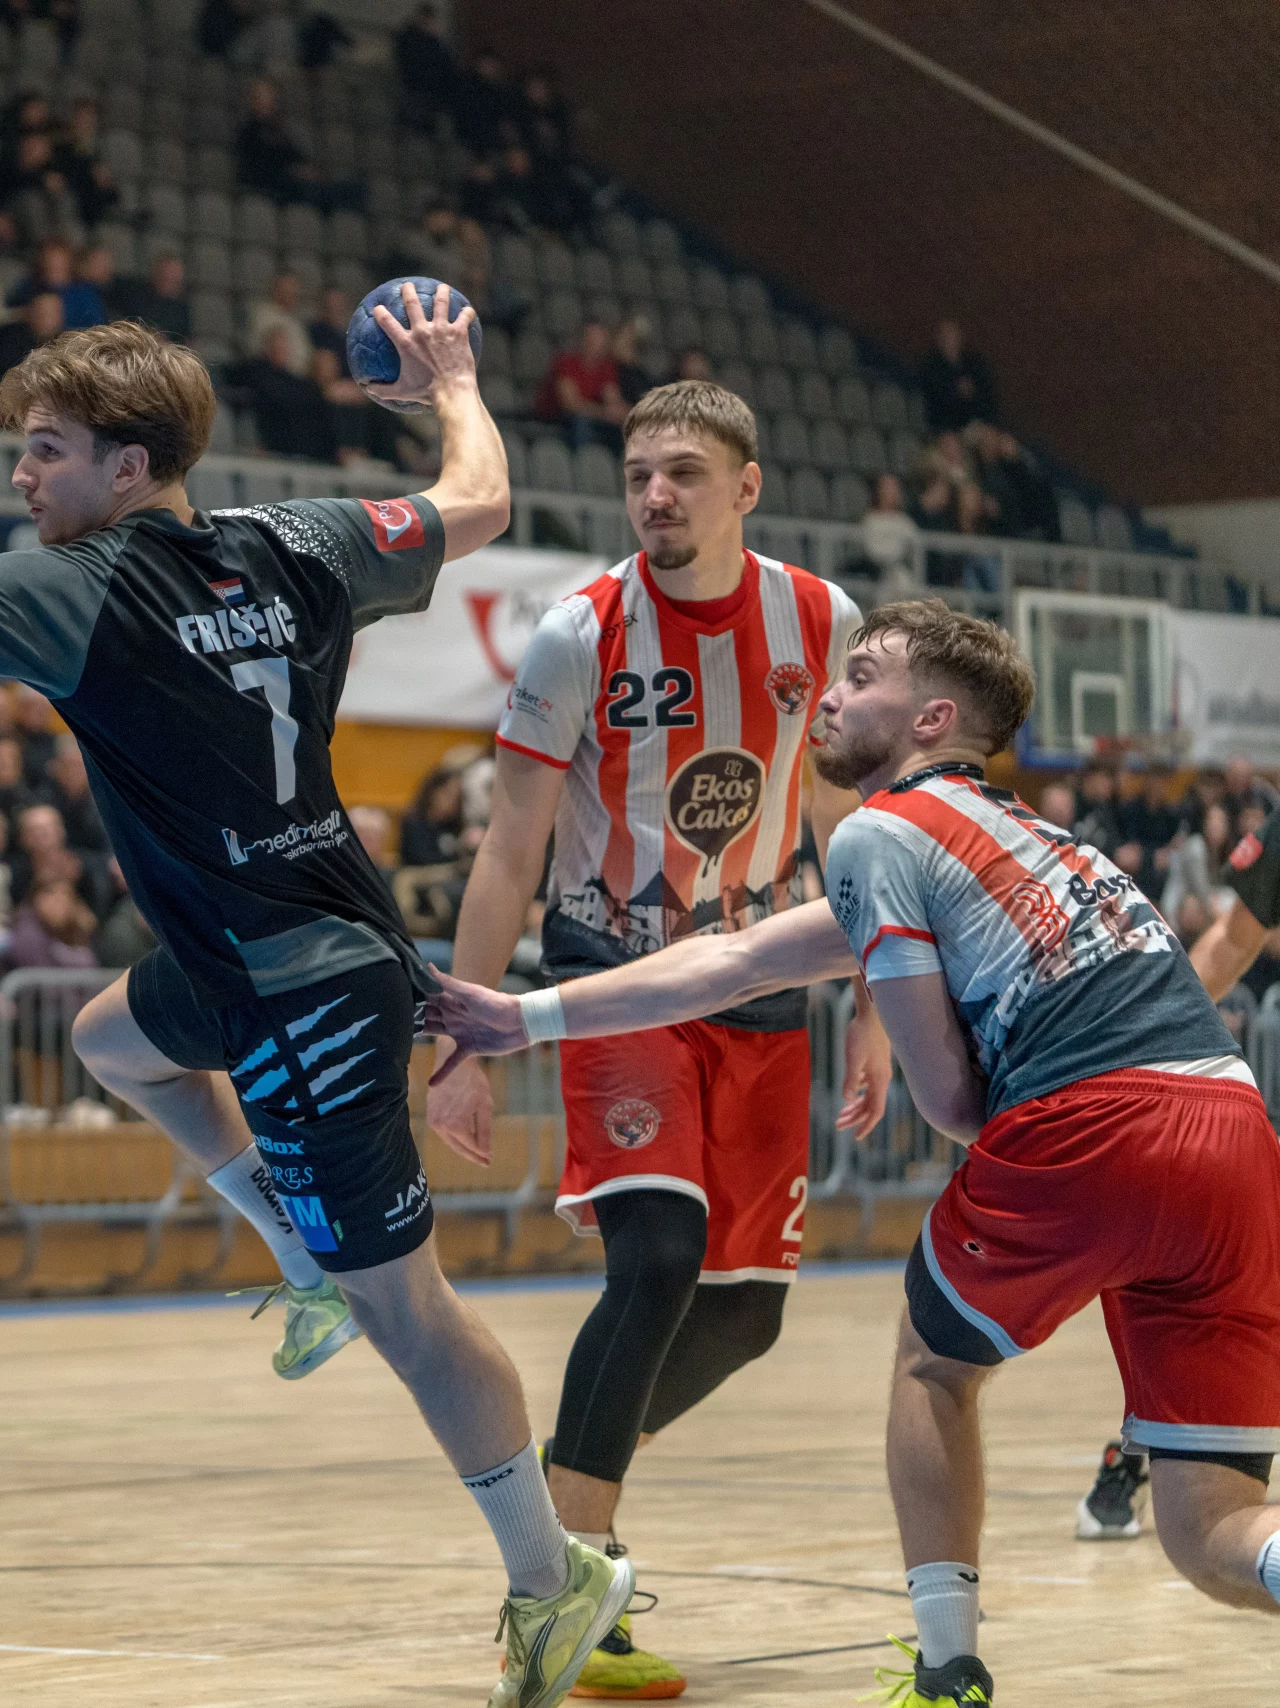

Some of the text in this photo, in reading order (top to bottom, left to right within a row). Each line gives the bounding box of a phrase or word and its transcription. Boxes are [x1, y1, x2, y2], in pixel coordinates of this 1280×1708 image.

[606, 667, 696, 729] 22
[230, 656, 299, 806] 7
[691, 773, 755, 802] Ekos
